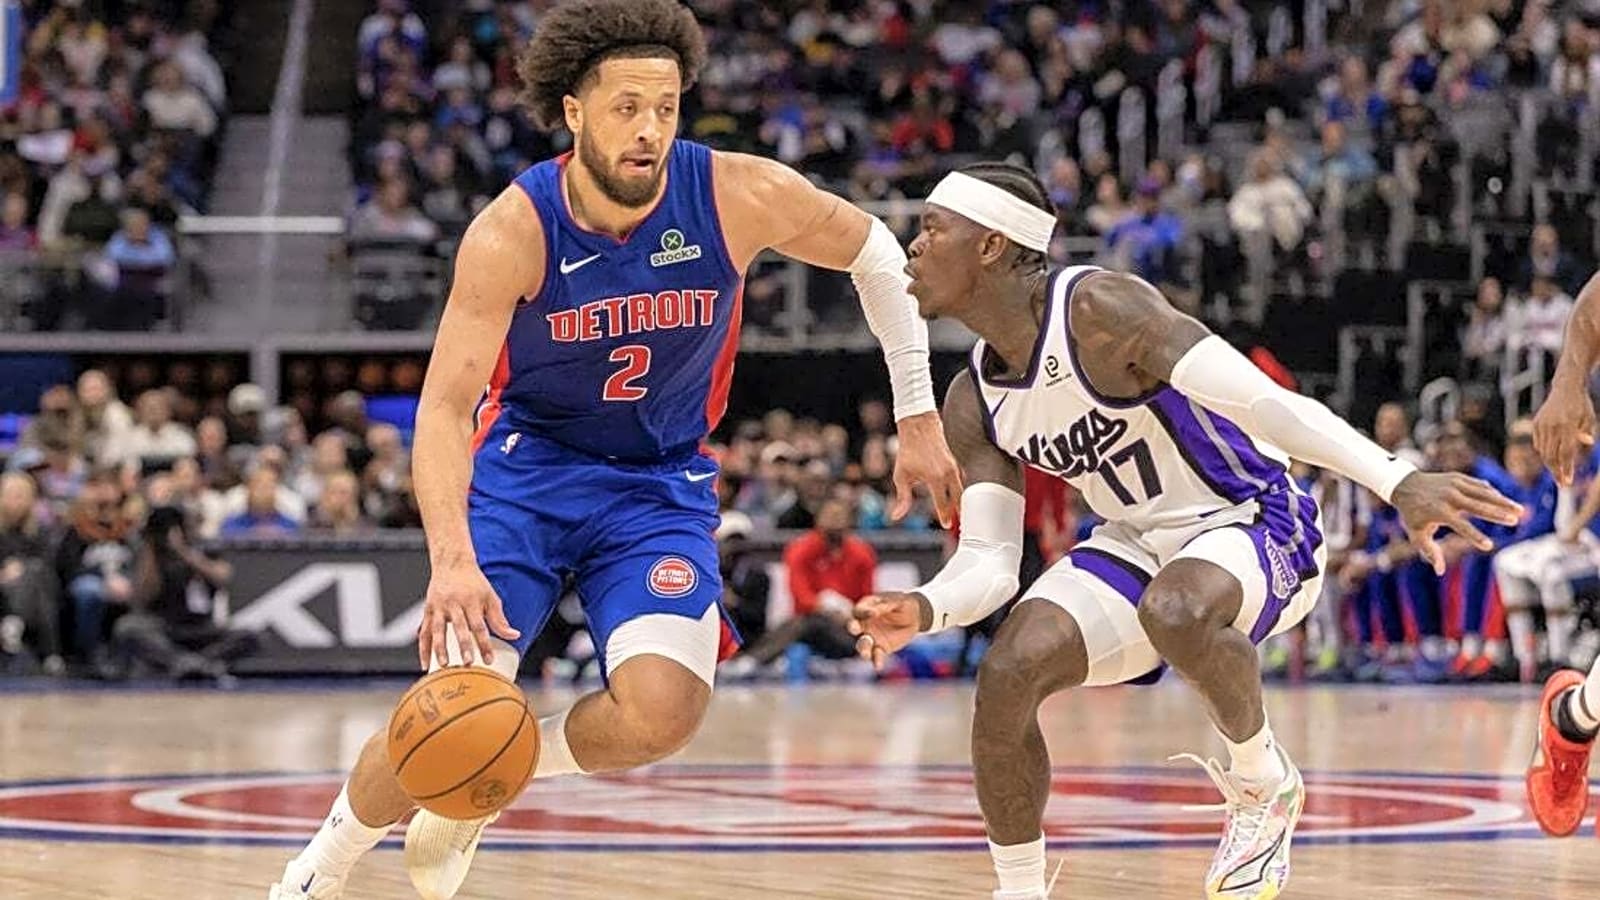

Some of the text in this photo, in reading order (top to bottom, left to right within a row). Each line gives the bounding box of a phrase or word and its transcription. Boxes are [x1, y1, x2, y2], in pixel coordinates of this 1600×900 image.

[653, 247, 699, 264] StockX
[546, 289, 718, 342] DETROIT
[603, 344, 651, 401] 2
[1099, 438, 1163, 506] 17
